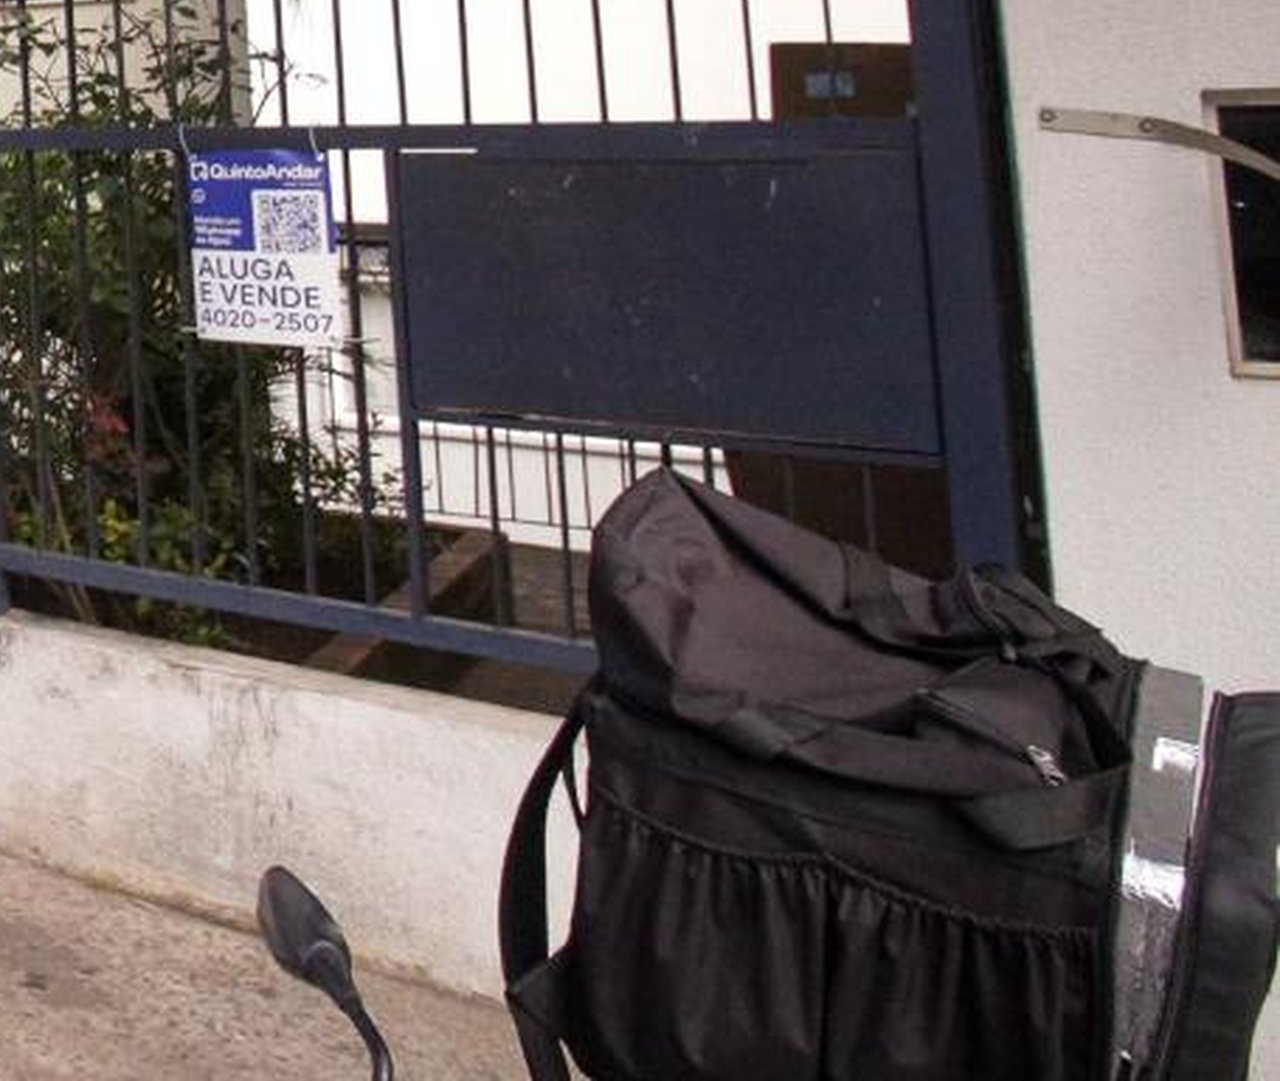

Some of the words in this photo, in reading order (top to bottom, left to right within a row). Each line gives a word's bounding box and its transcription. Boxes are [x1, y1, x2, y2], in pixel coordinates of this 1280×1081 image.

[210, 163, 322, 181] QuintoAndar
[198, 255, 295, 281] ALUGA
[200, 281, 213, 303] E
[219, 283, 321, 309] VENDE
[201, 307, 334, 334] 4020-2507
